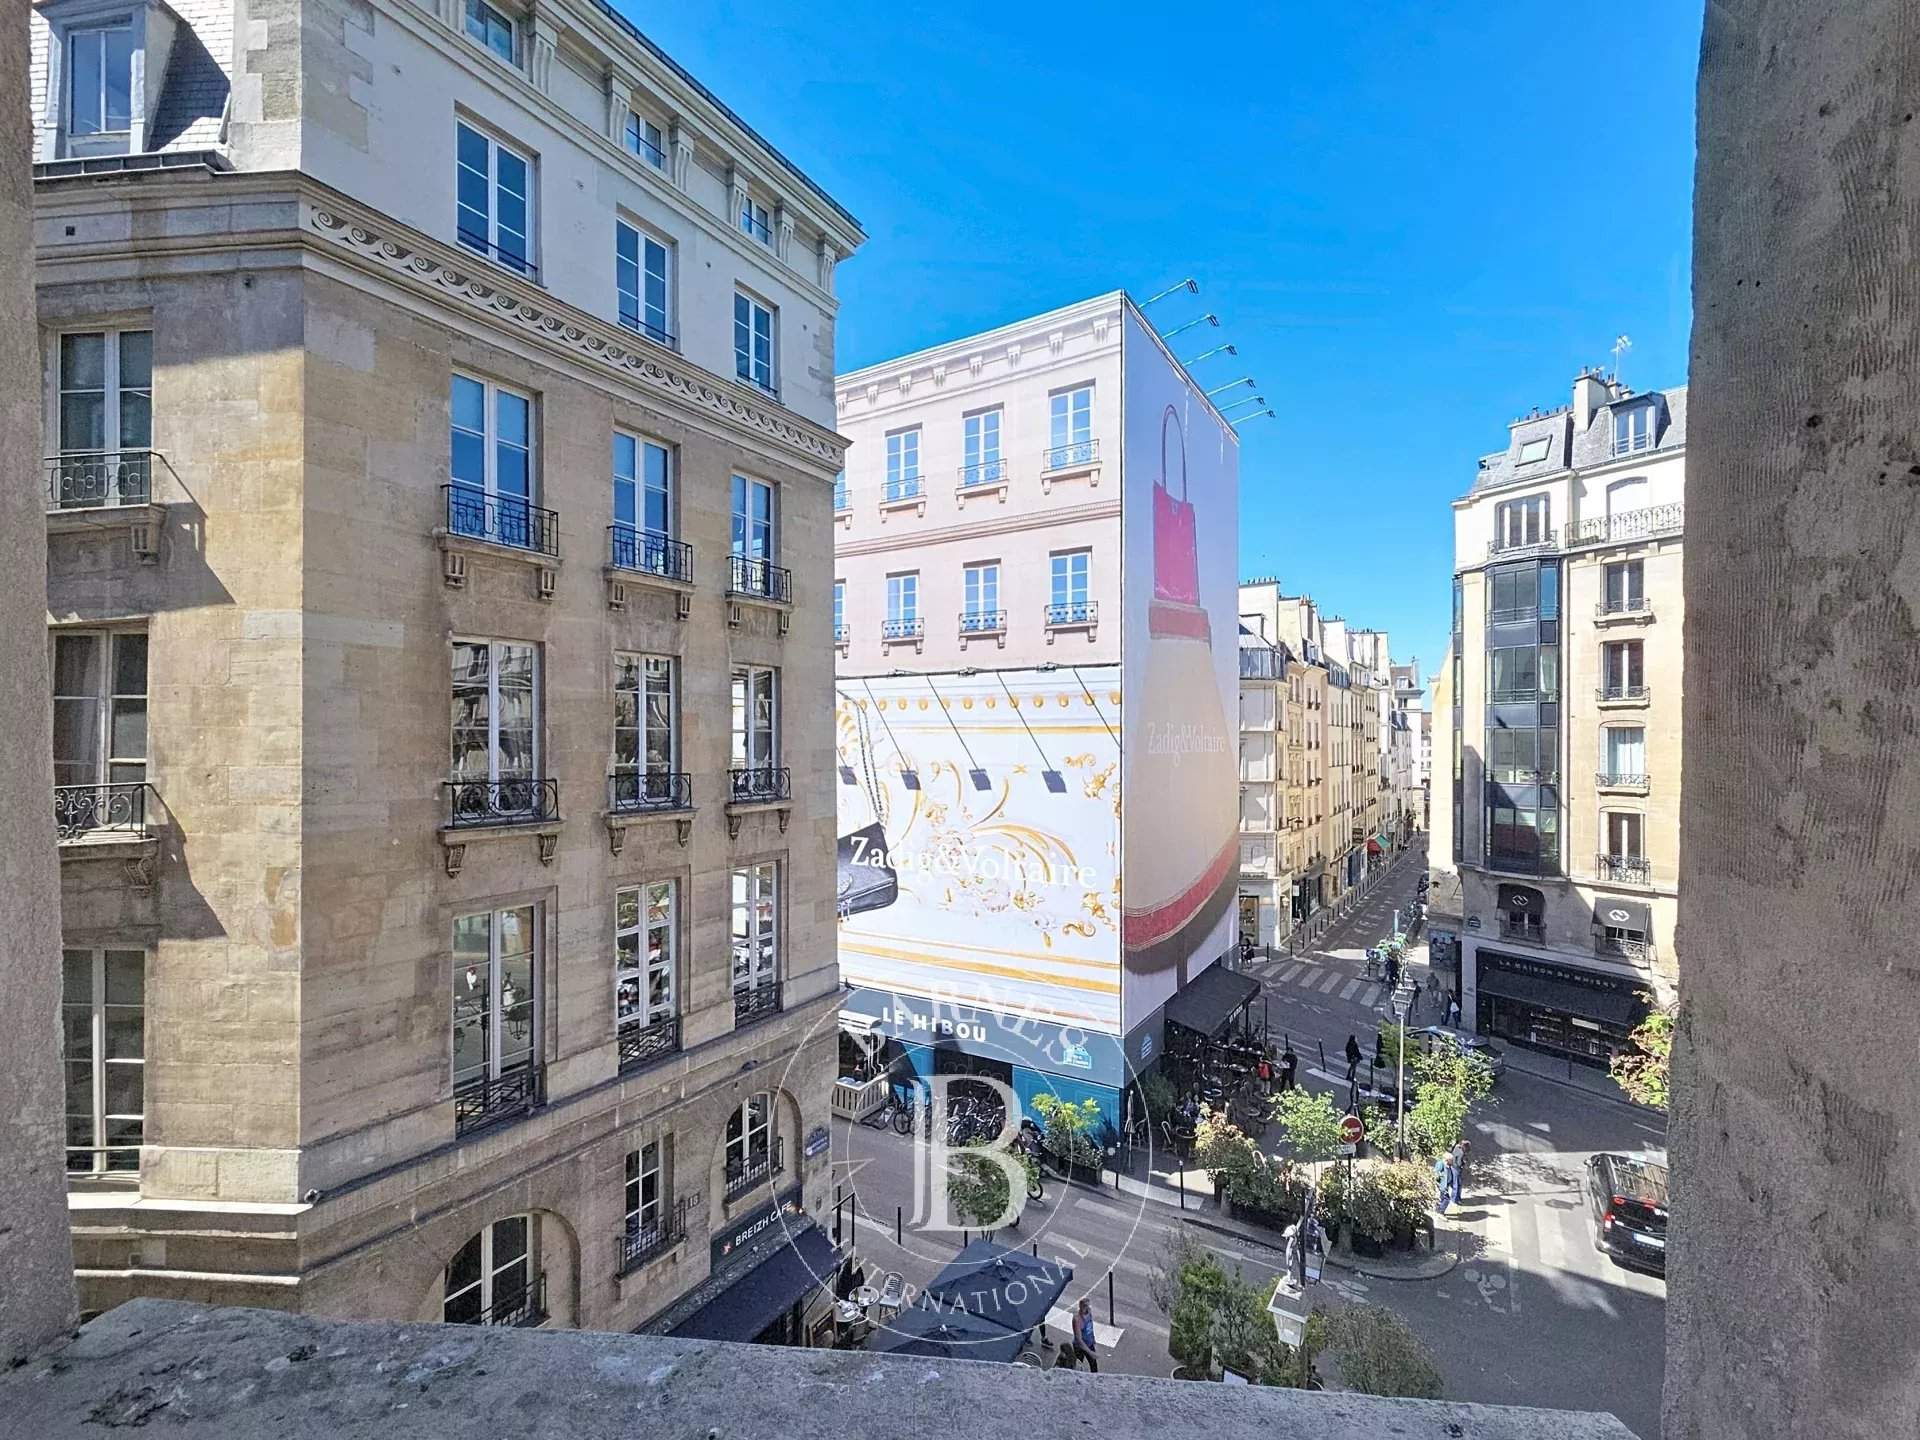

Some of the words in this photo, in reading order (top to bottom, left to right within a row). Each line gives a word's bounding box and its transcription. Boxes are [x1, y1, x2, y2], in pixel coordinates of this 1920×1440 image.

[1514, 963, 1553, 976] MAISON
[882, 1007, 904, 1026] LE
[913, 1013, 987, 1043] HIBOU
[735, 1215, 769, 1247] BREIZH
